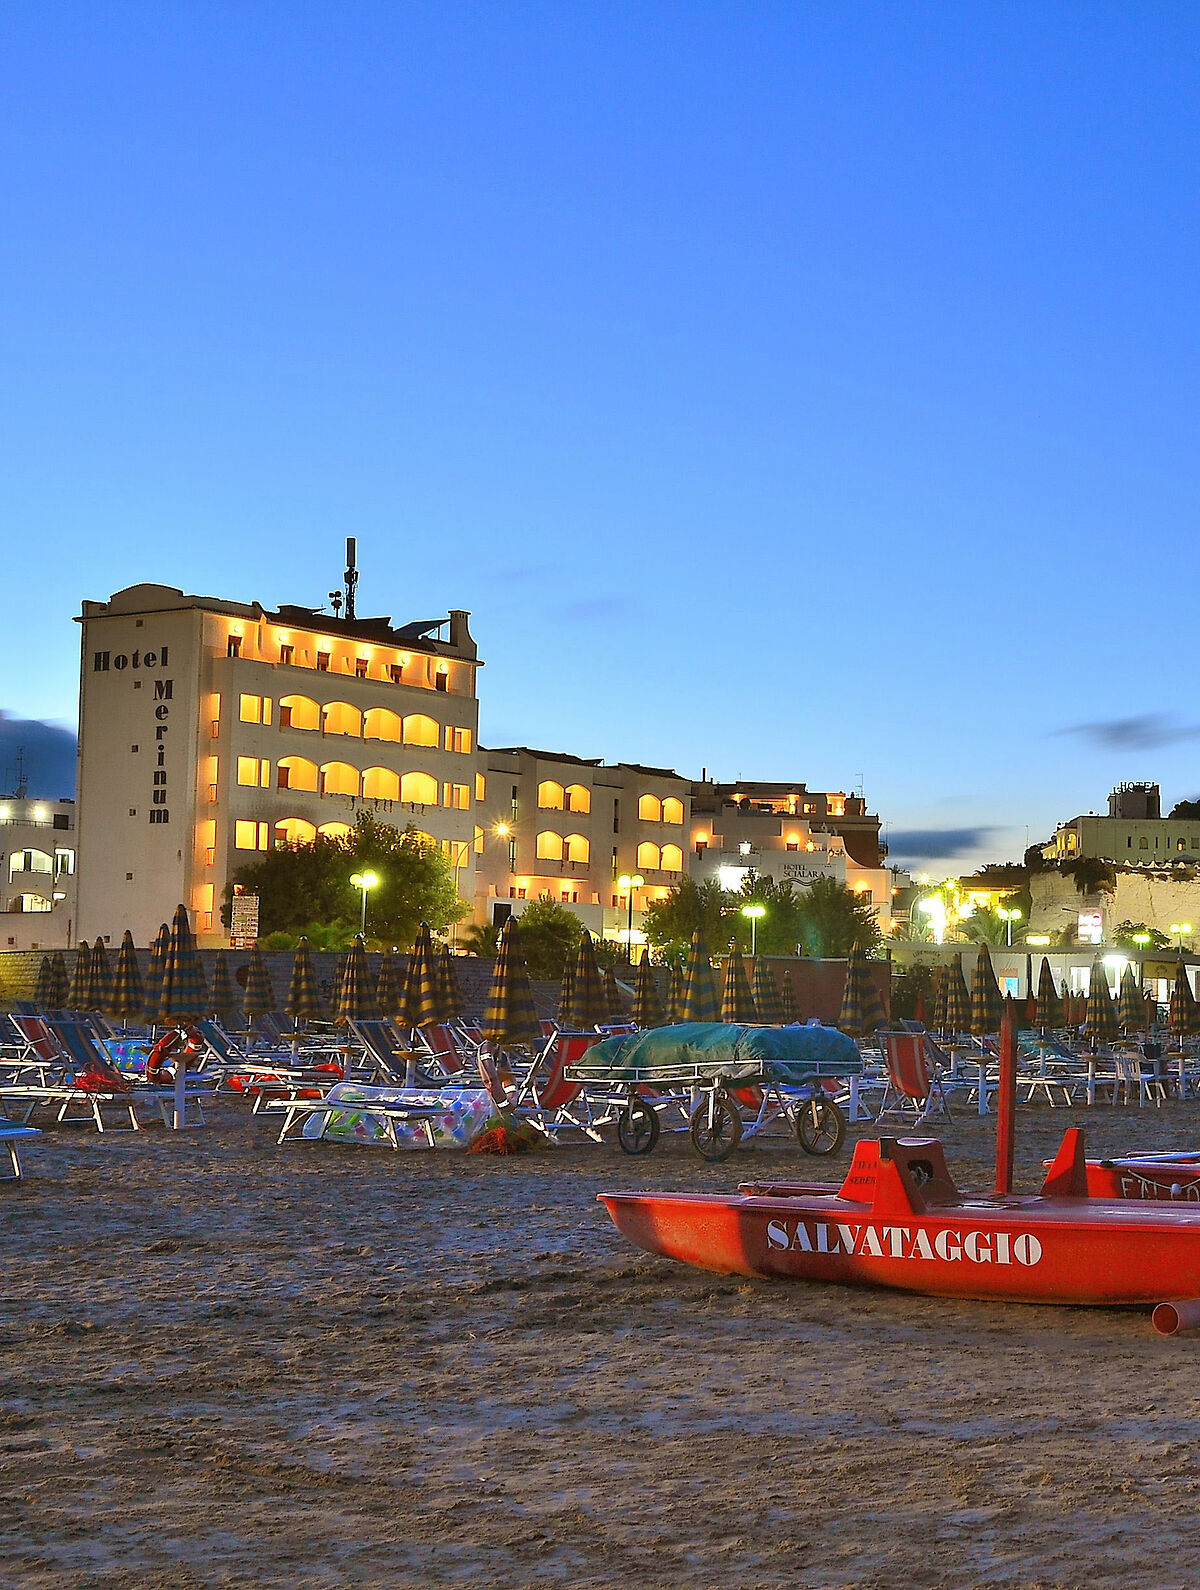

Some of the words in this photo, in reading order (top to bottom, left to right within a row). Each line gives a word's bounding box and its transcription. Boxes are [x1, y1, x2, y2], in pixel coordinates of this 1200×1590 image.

[93, 646, 169, 672] Hotel
[149, 679, 174, 824] Merinum
[766, 1219, 1043, 1266] SALVATAGGIO
